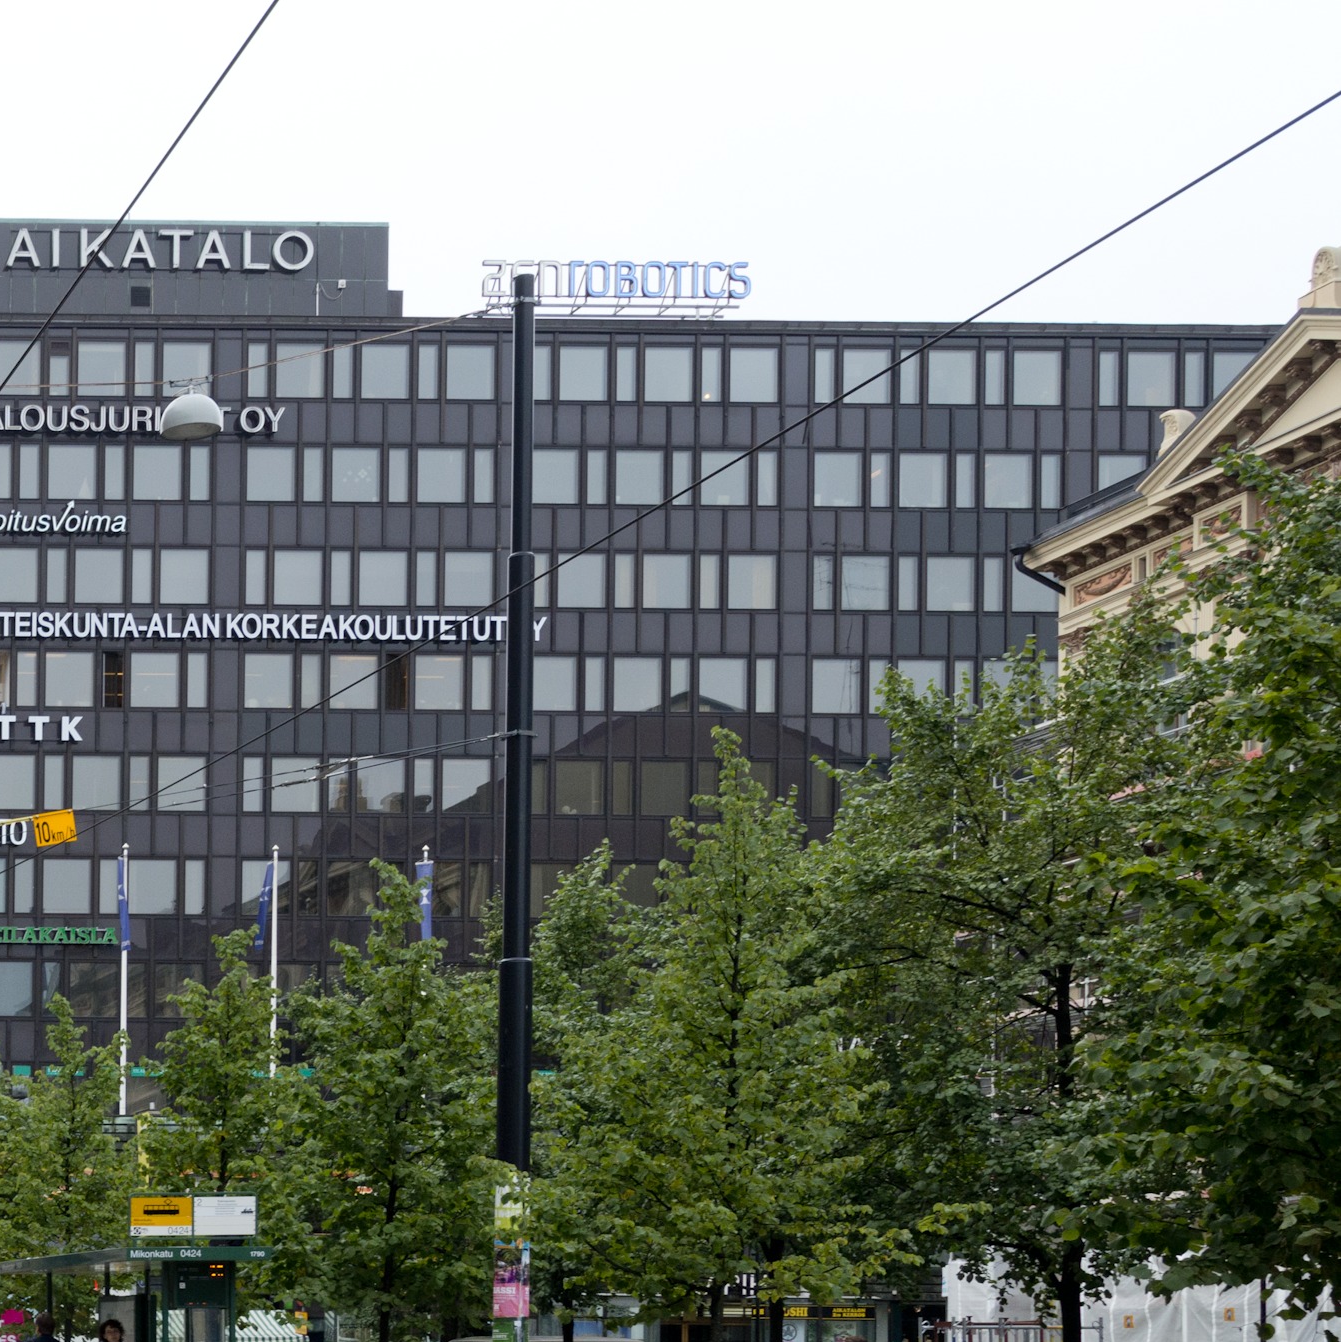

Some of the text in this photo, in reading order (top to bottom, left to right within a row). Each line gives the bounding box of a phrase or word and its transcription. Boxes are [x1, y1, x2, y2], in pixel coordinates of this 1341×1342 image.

[6, 228, 315, 271] AIKATALO
[240, 405, 286, 434] OY
[226, 612, 508, 642] KORKEAKOULUTETUT
[168, 1226, 190, 1235] 0424
[130, 1249, 174, 1259] Mikonkatu
[180, 1249, 202, 1258] 0424
